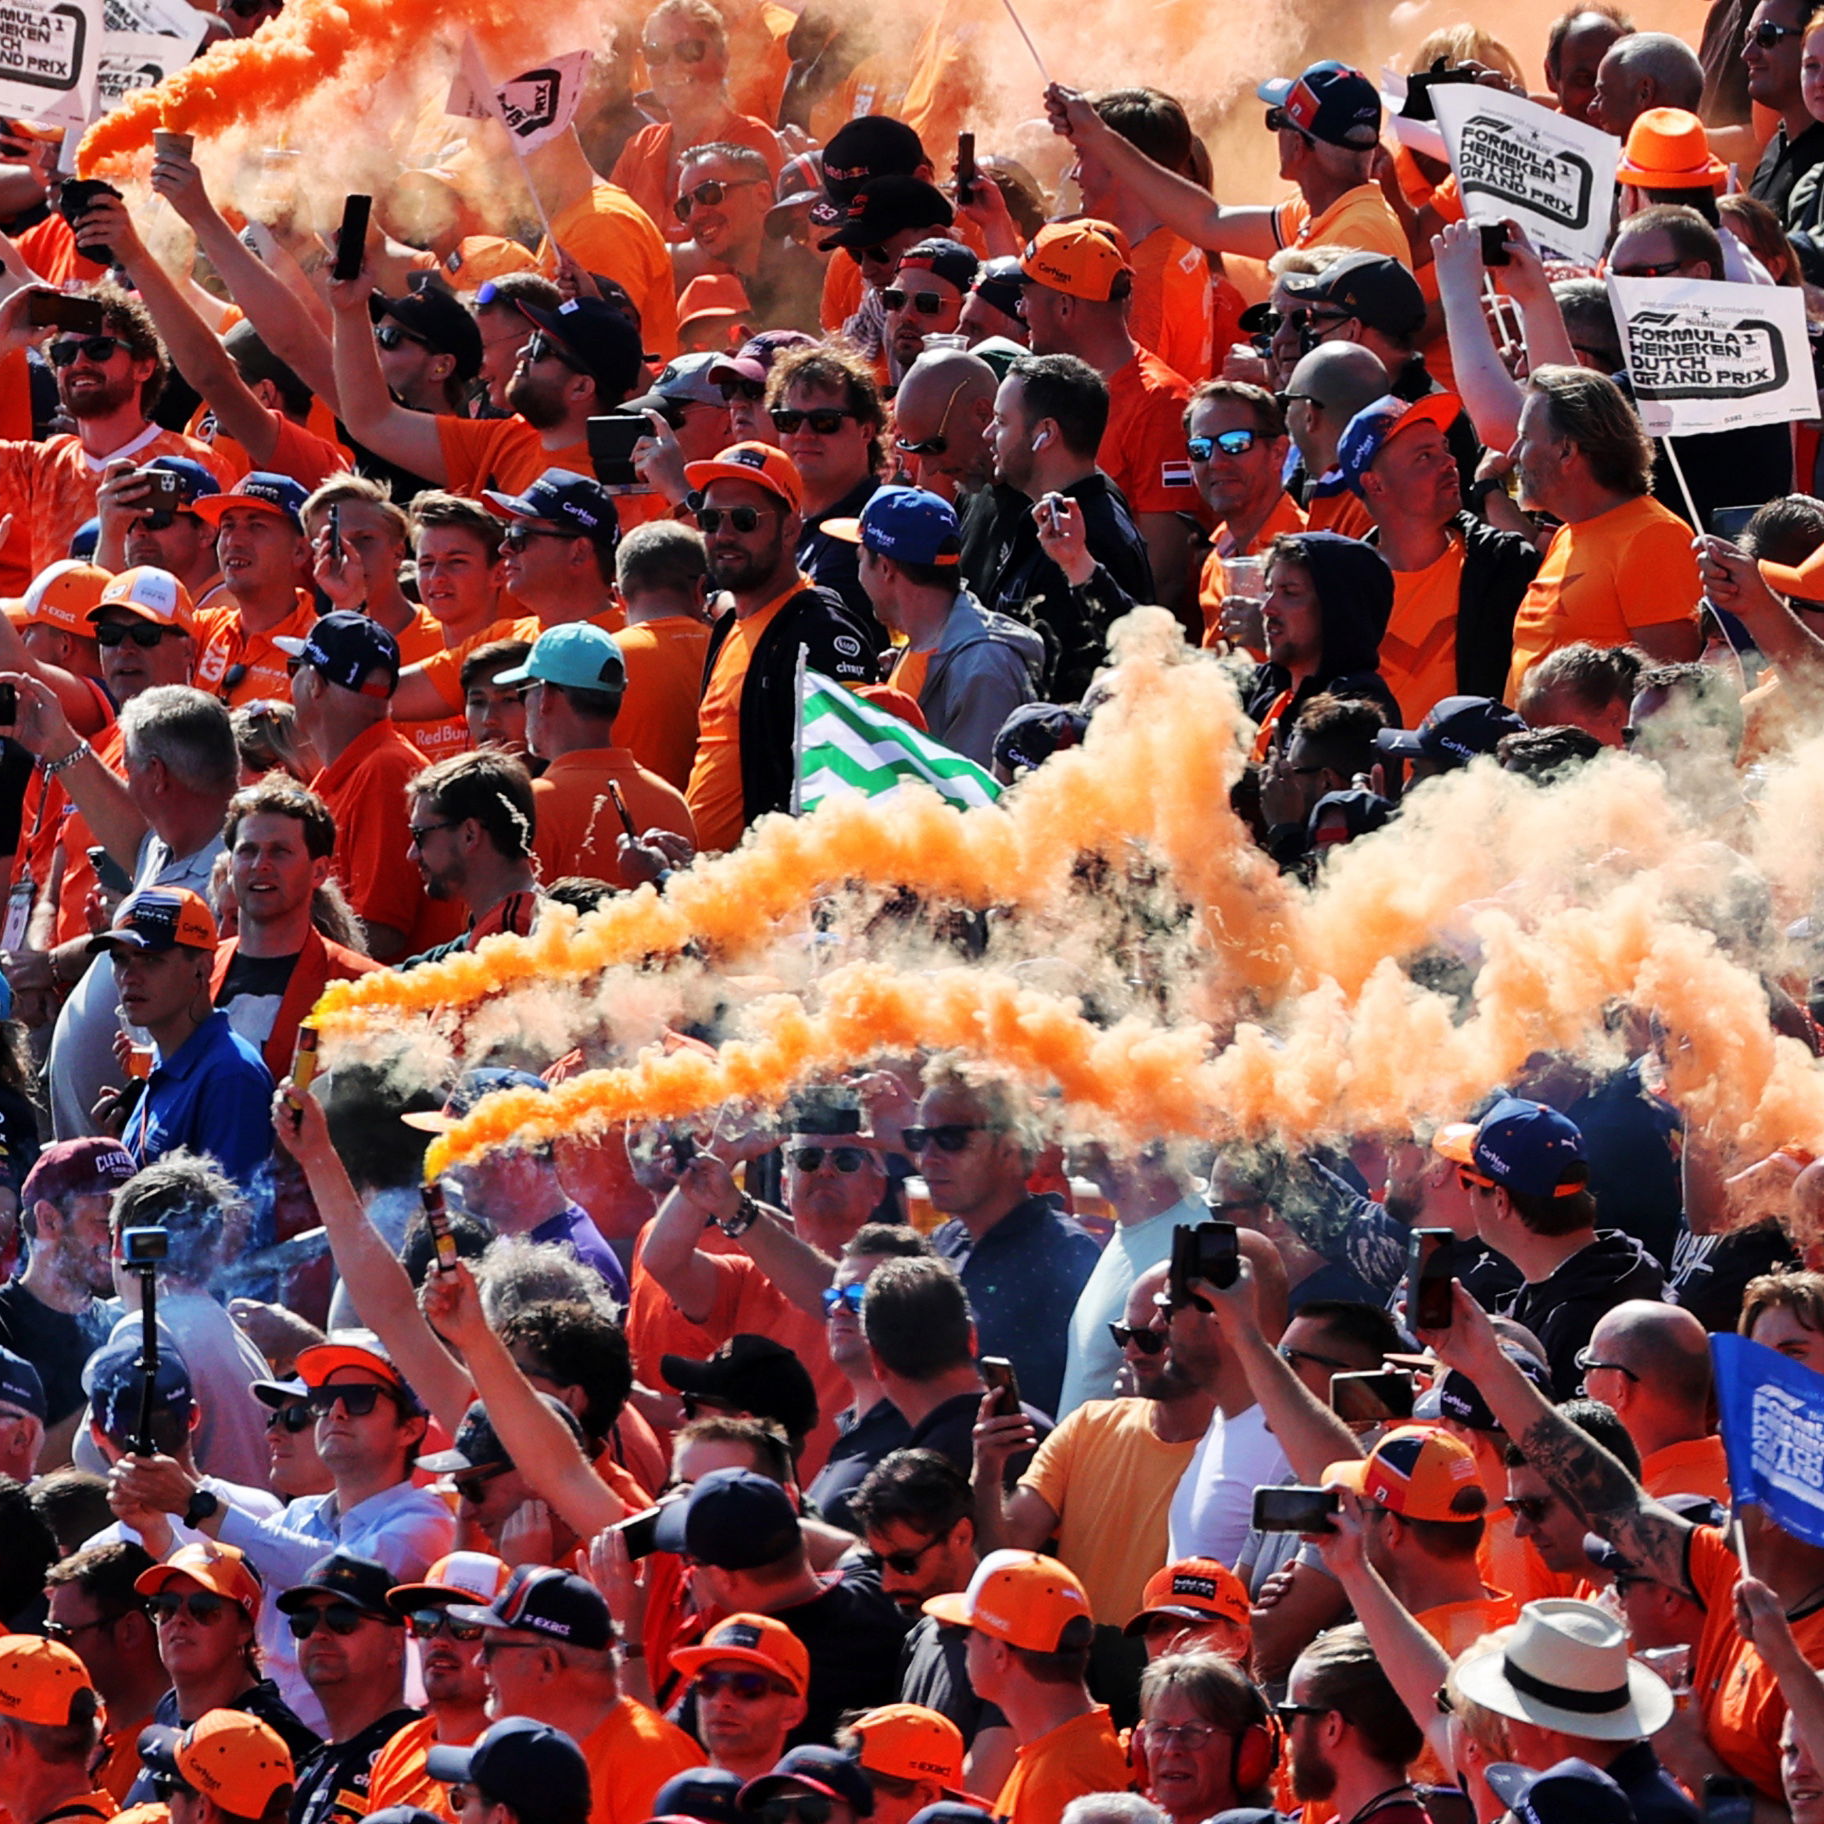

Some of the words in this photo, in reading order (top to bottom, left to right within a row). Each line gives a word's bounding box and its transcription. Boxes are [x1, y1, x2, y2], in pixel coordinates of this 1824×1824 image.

[55, 19, 65, 31] 1
[28, 57, 67, 76] PRIX
[1462, 127, 1554, 169] FORMULA
[1561, 162, 1570, 176] 1
[1460, 153, 1524, 183] DUTCH
[1461, 140, 1555, 183] HEINEKEN
[1461, 166, 1527, 195] GRAND
[1531, 189, 1573, 216] PRIX
[812, 203, 838, 221] 33
[1038, 262, 1071, 281] CarNext
[1628, 326, 1738, 346] FORMULA
[1744, 332, 1755, 344] 1
[1630, 340, 1741, 356] HEINEKEN
[1631, 356, 1706, 369] DUTCH
[1633, 370, 1711, 385] GRAND
[1716, 368, 1769, 384] PRIX
[563, 502, 598, 525] CarNext
[416, 728, 440, 745] Red
[1480, 1144, 1511, 1172] CarNext
[534, 1616, 570, 1635] exact
